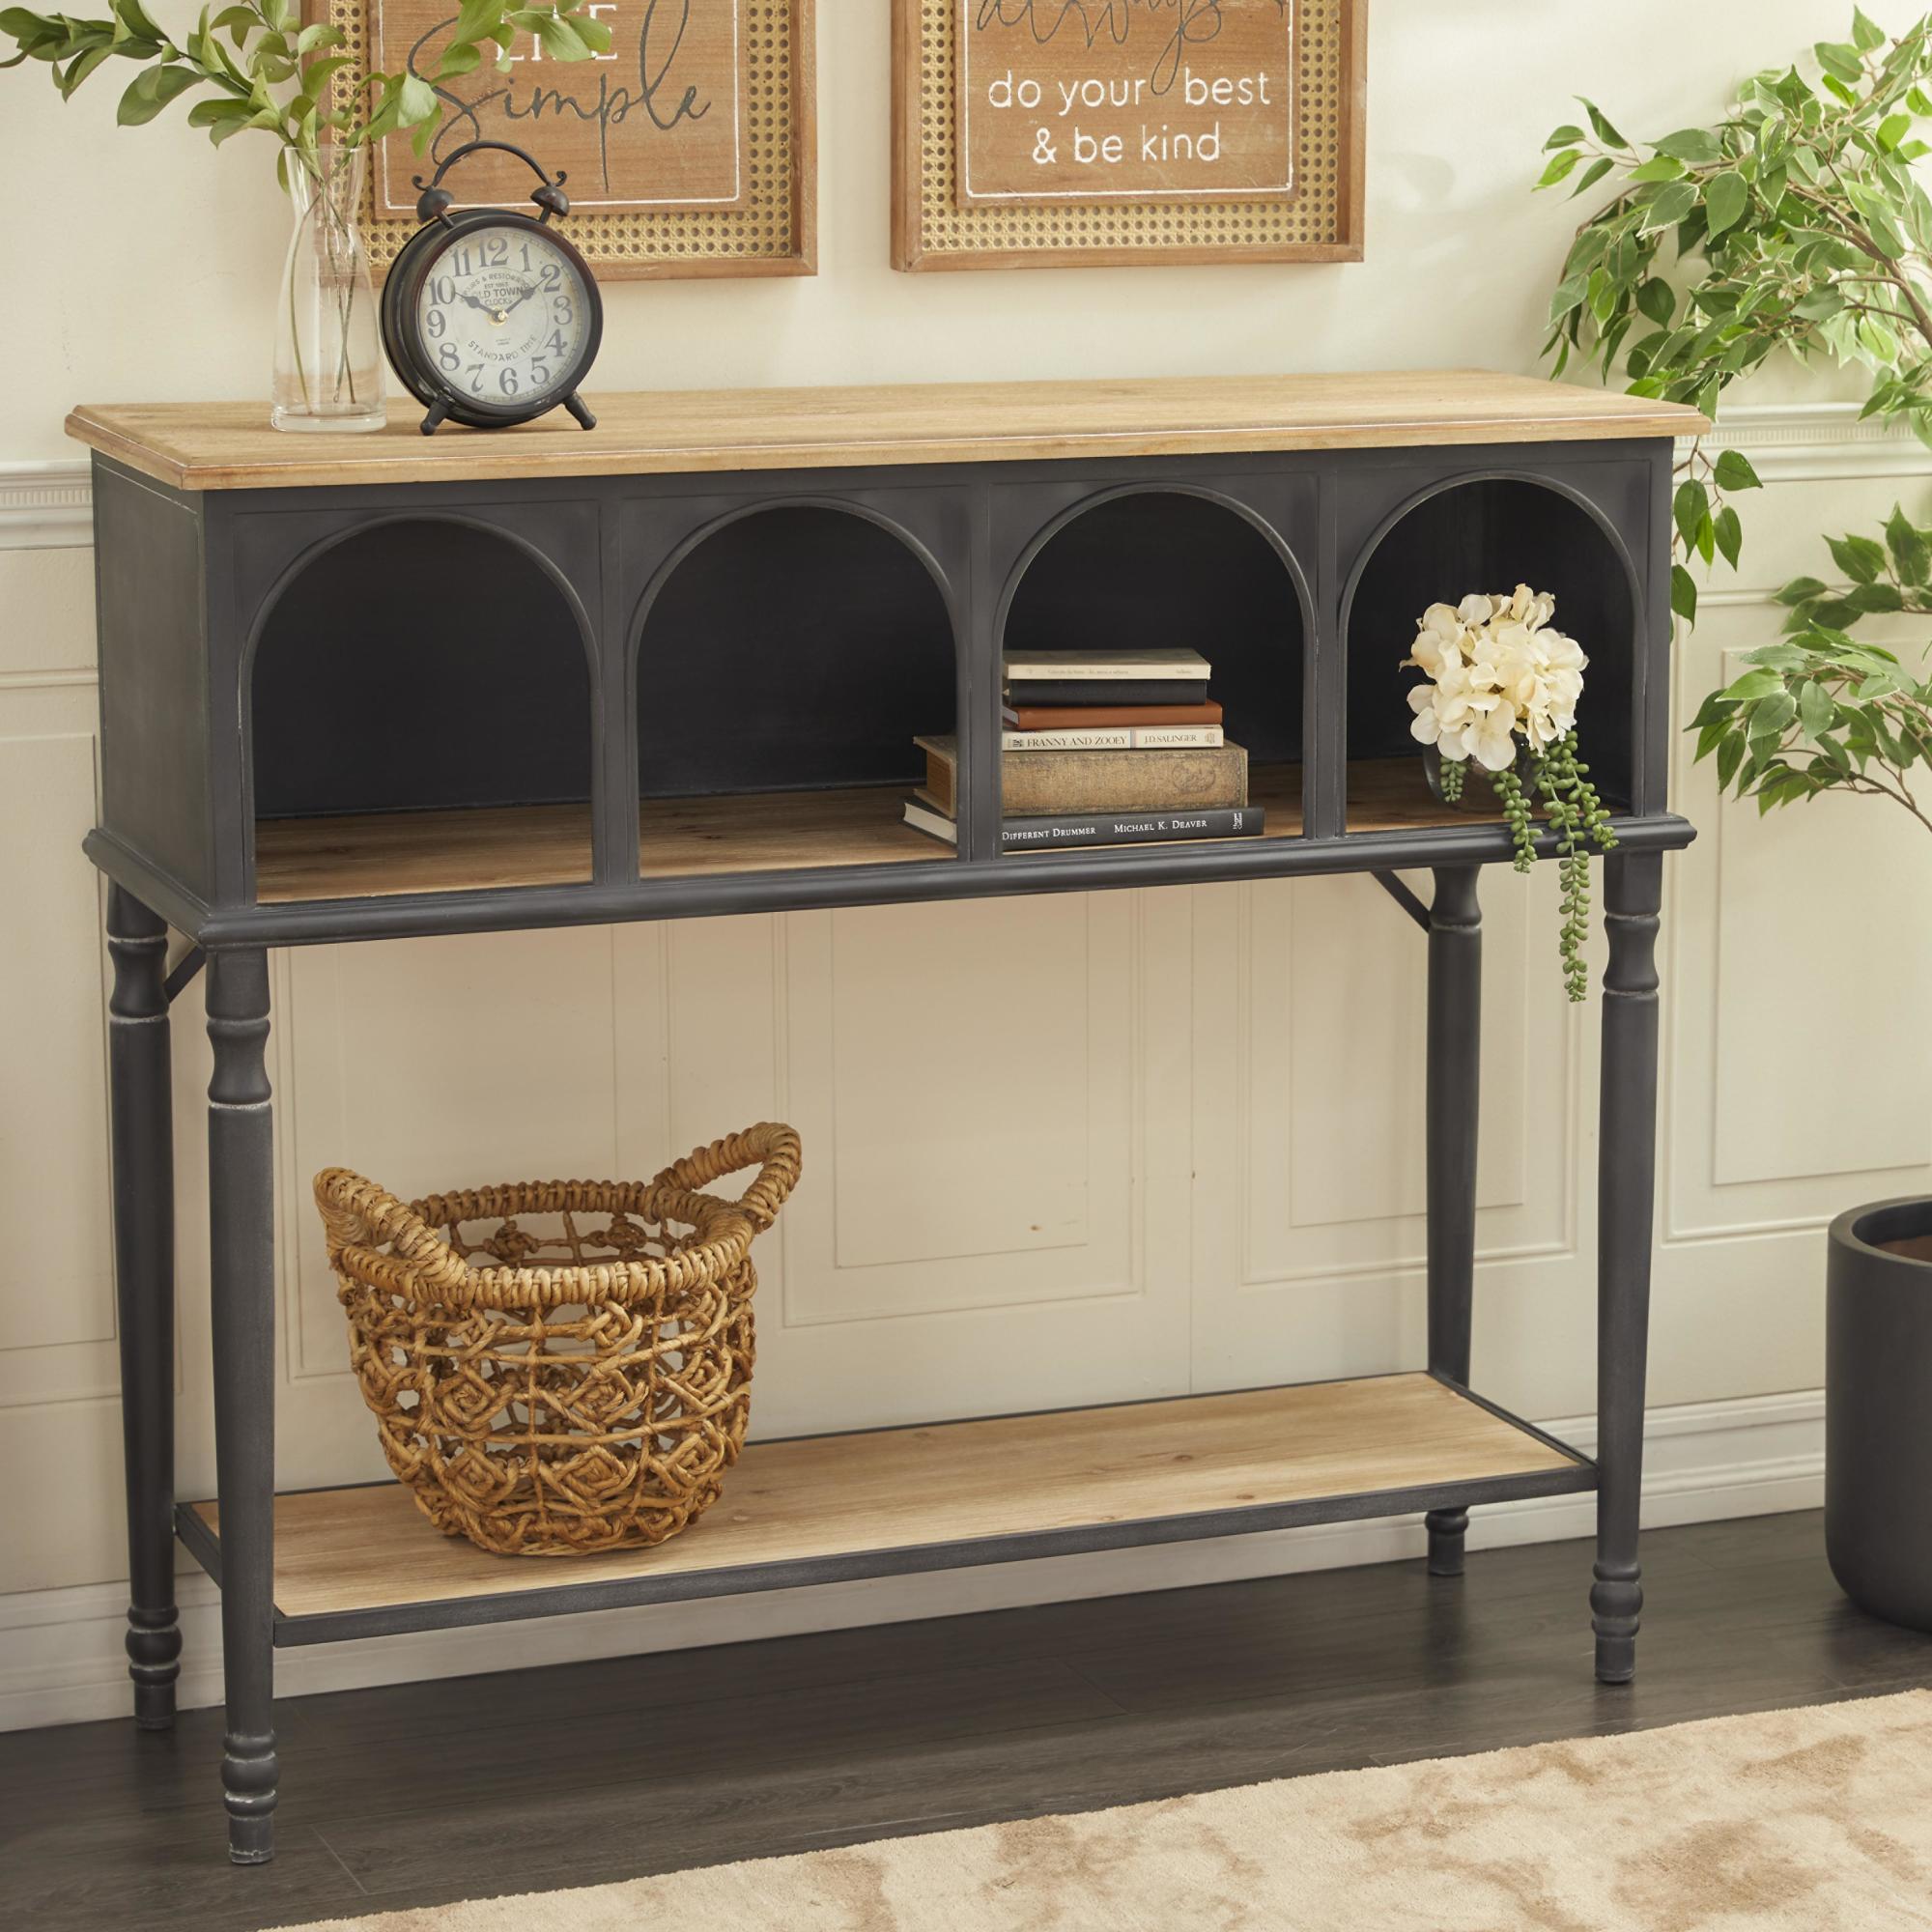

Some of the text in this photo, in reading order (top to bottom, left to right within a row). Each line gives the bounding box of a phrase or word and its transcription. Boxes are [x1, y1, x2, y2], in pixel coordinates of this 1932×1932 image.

[408, 0, 712, 193] Simple
[988, 69, 1271, 116] do your best
[1032, 122, 1221, 164] & be kind
[451, 247, 471, 277] 11
[478, 238, 509, 267] 12
[520, 243, 533, 272] 1
[429, 275, 456, 306] 10
[540, 264, 561, 293] 2
[426, 309, 446, 338] 9
[554, 296, 573, 326] 3
[439, 342, 461, 372] 8
[545, 328, 568, 357] 4
[465, 363, 485, 393] 7
[498, 367, 519, 396] 6
[530, 355, 550, 384] 5
[1027, 737, 1067, 747] FRANNY
[1070, 736, 1093, 746] AND
[1094, 735, 1127, 745] ZOOEY
[1002, 826, 1096, 840] DIFFERENT DRUMMER
[1114, 819, 1208, 833] MICHAEL K. DEAVER
